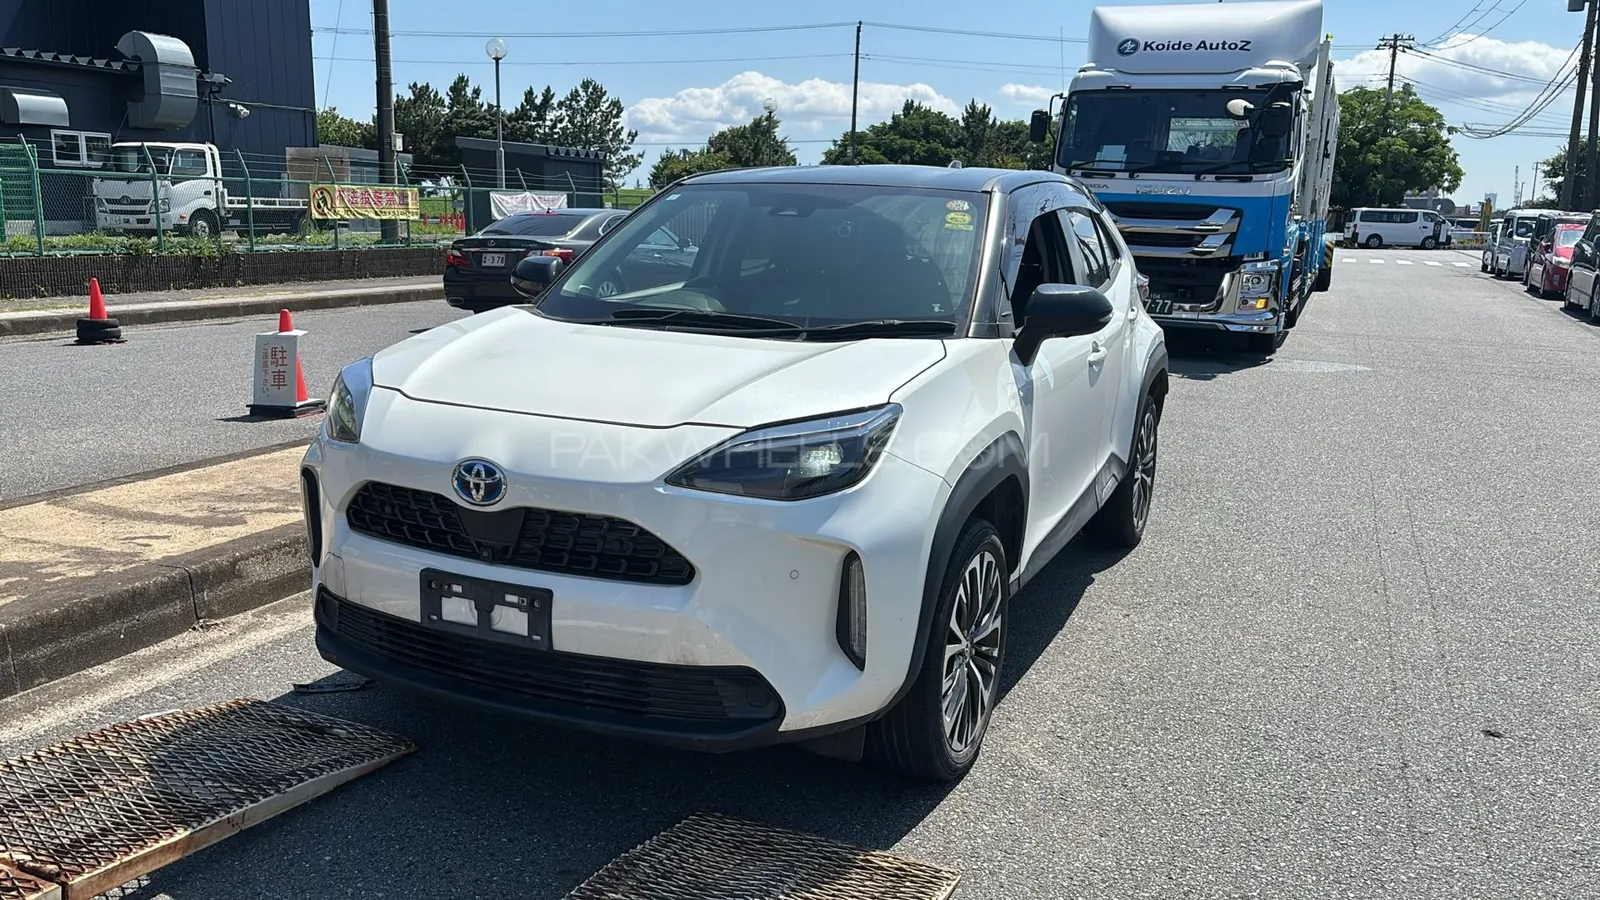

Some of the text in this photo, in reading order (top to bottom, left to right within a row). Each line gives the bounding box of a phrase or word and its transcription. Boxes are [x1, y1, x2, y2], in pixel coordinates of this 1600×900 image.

[1143, 40, 1252, 52] Koide AutoZ
[1136, 185, 1192, 195] ISUZU
[1144, 299, 1172, 313] 7-77
[270, 346, 288, 390] 駐車
